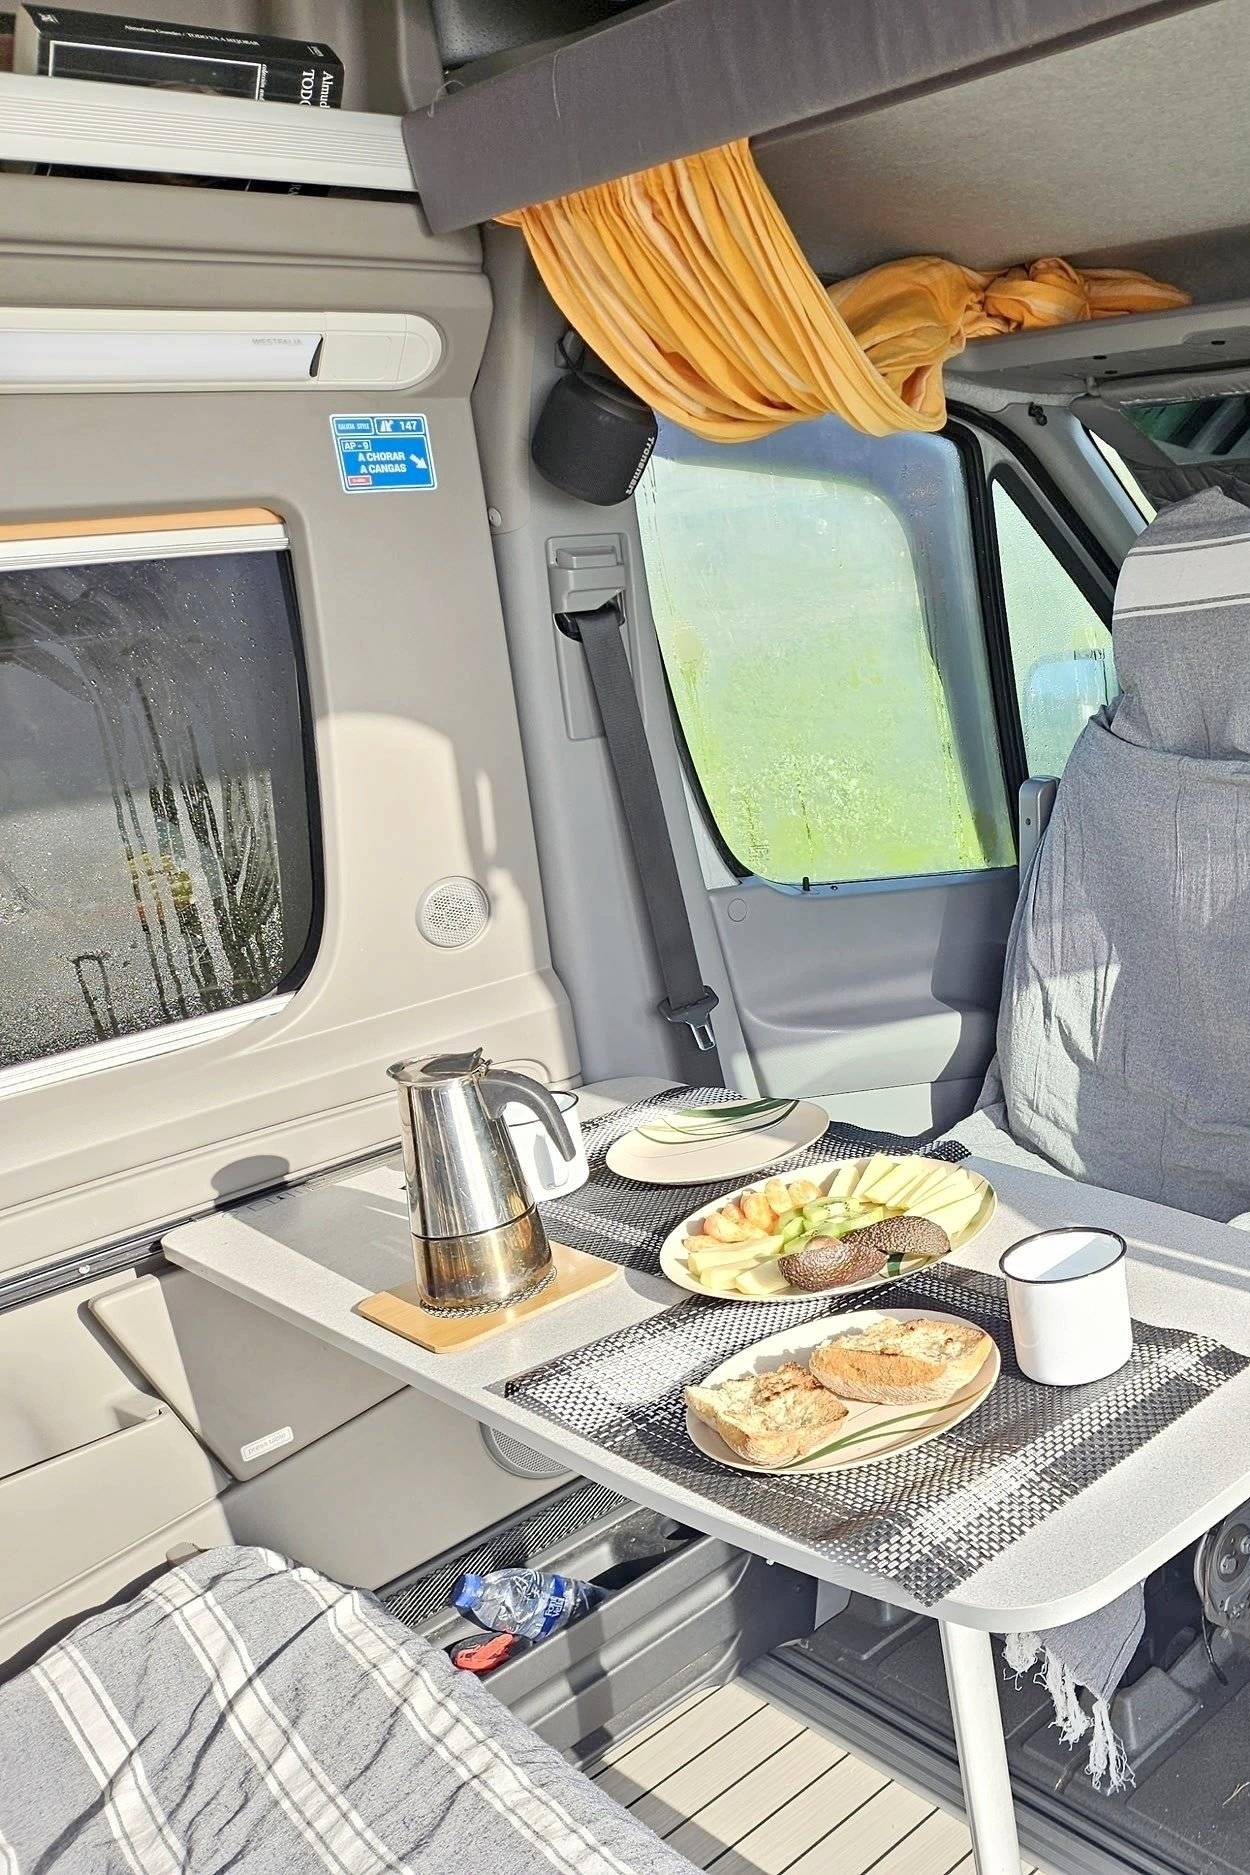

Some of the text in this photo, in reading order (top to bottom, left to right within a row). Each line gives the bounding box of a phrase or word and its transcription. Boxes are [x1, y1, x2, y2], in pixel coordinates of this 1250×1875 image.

[399, 420, 417, 431] 147
[358, 451, 406, 462] A CHORAR
[360, 463, 407, 473] A CANGAS
[625, 436, 655, 495] Tronsmart
